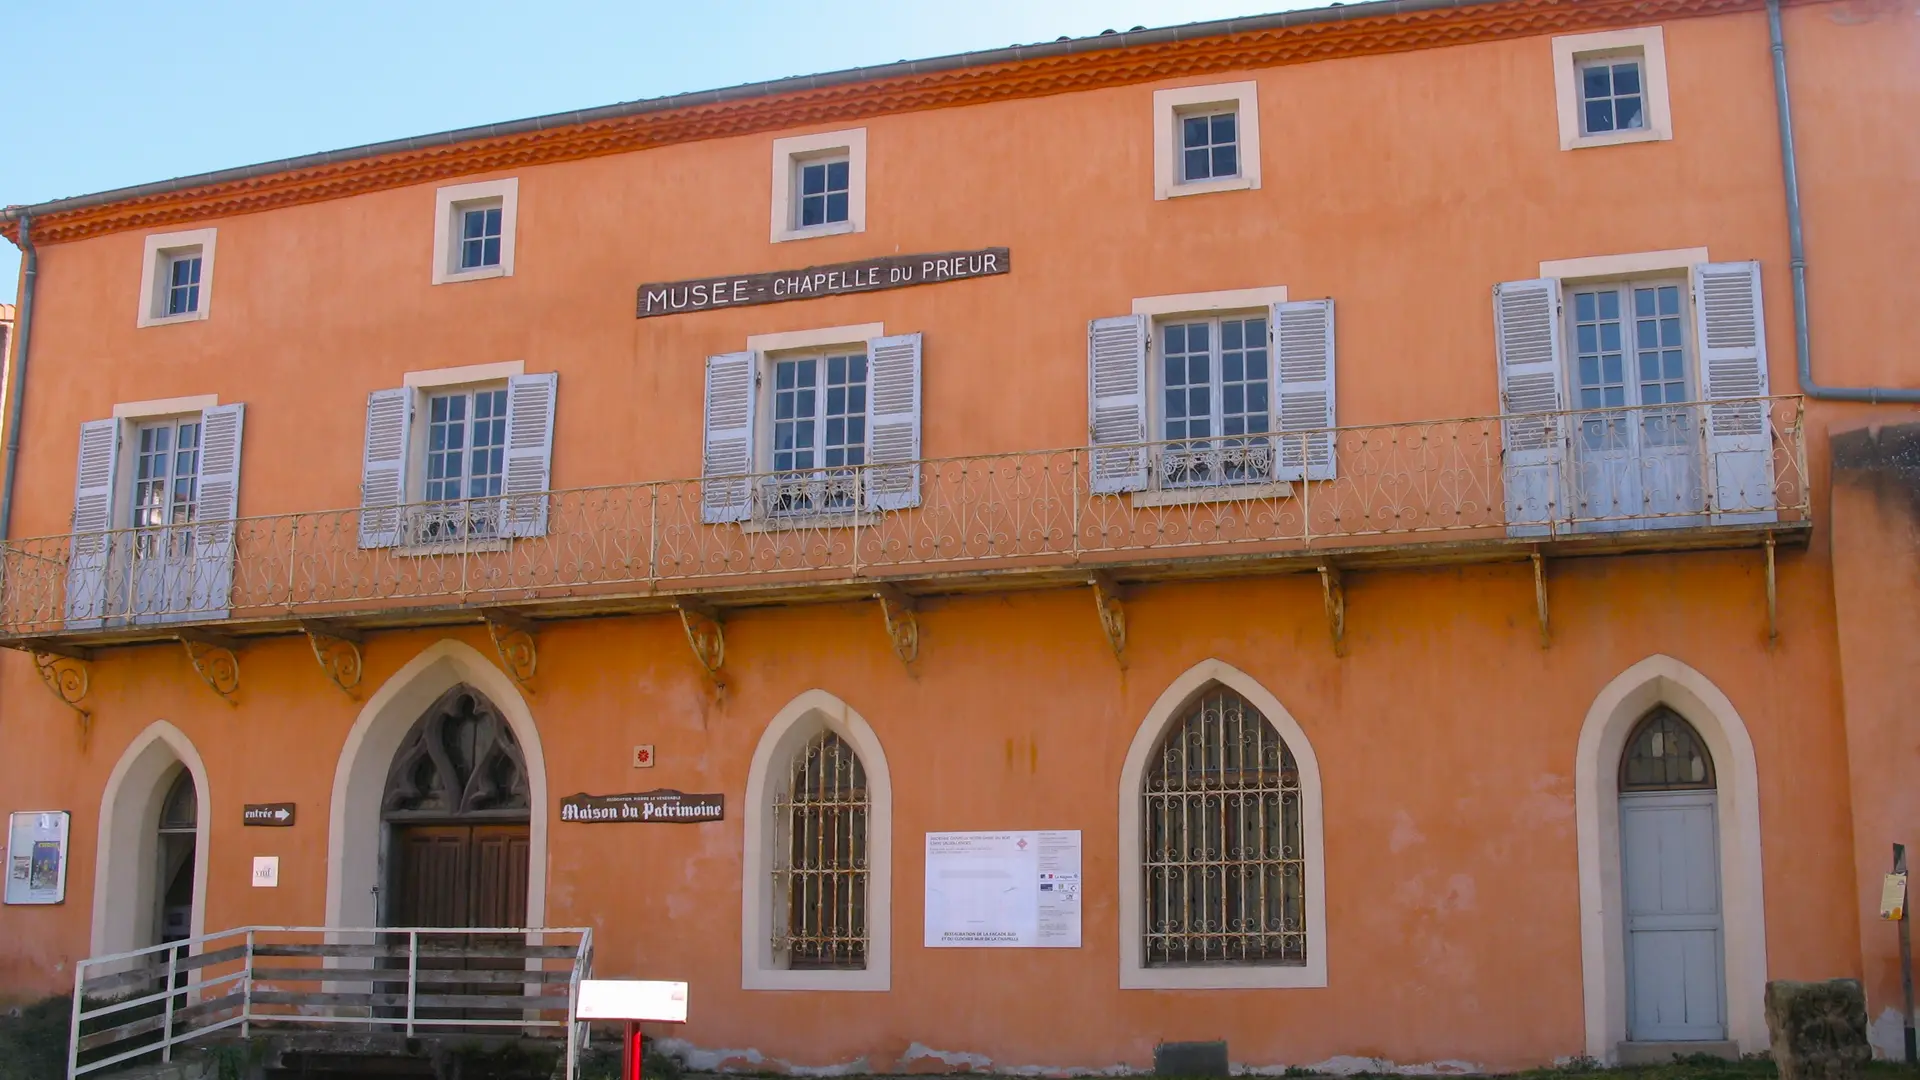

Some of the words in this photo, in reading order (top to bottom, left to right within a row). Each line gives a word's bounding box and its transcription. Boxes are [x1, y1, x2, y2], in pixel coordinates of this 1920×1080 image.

[646, 279, 750, 312] MUSEE
[773, 267, 880, 296] CHAPELLE
[890, 266, 912, 283] DU
[922, 253, 997, 279] PRIEUR
[245, 807, 273, 819] entrée
[562, 803, 618, 820] Maison
[622, 802, 638, 818] du
[642, 801, 722, 819] Patrimoine
